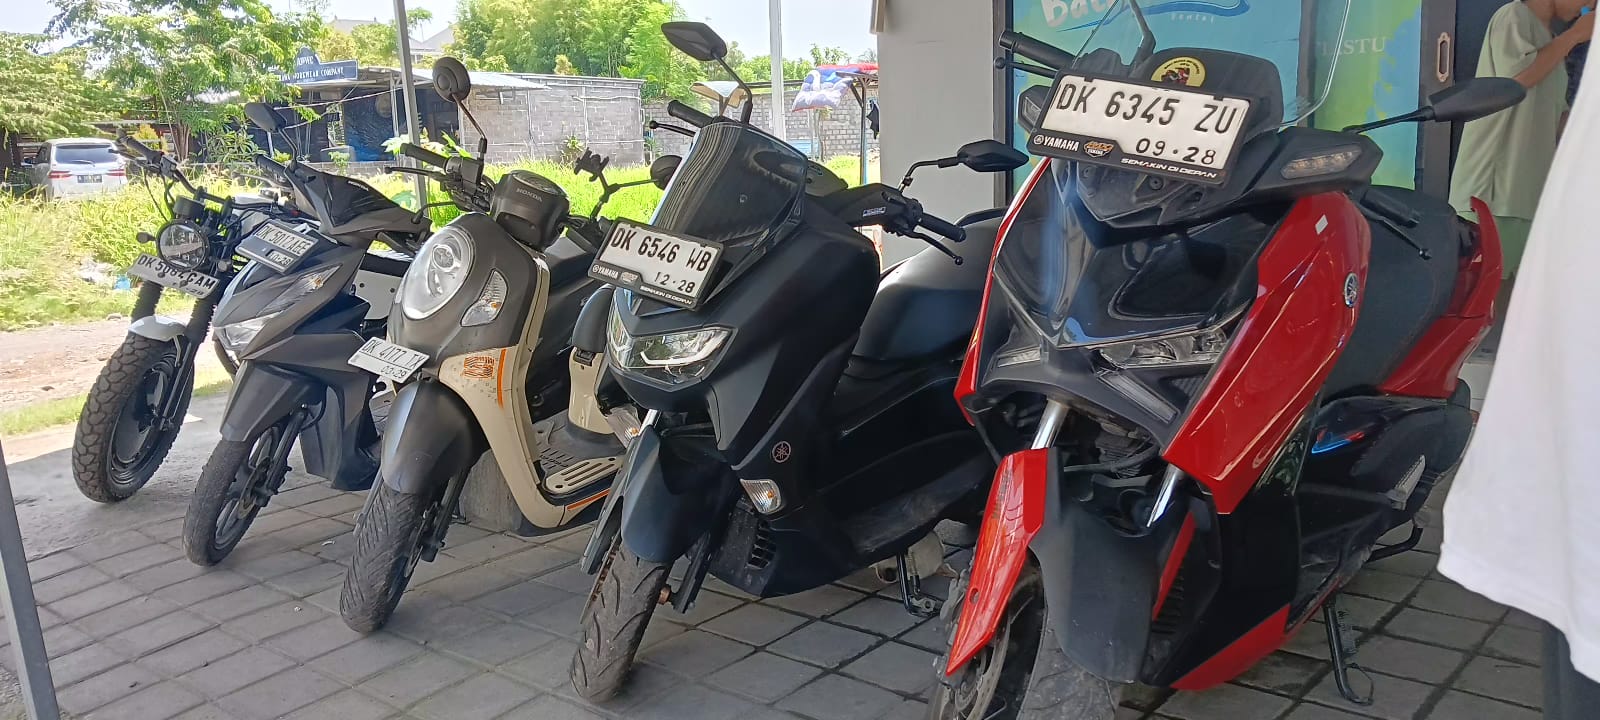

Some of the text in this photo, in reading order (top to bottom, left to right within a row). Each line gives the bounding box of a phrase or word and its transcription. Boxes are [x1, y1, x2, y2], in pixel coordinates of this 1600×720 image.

[1056, 83, 1237, 134] DK 6345 ZU
[1043, 135, 1080, 152] YAMAHA
[1120, 158, 1168, 171] SEMAKIN
[1179, 168, 1217, 179] DEPAN
[516, 188, 543, 202] HONDA
[610, 228, 712, 272] DK 6546 WB
[137, 255, 157, 268] DK
[598, 266, 619, 280] YAMAHA
[362, 339, 425, 370] DK 4177 TX
